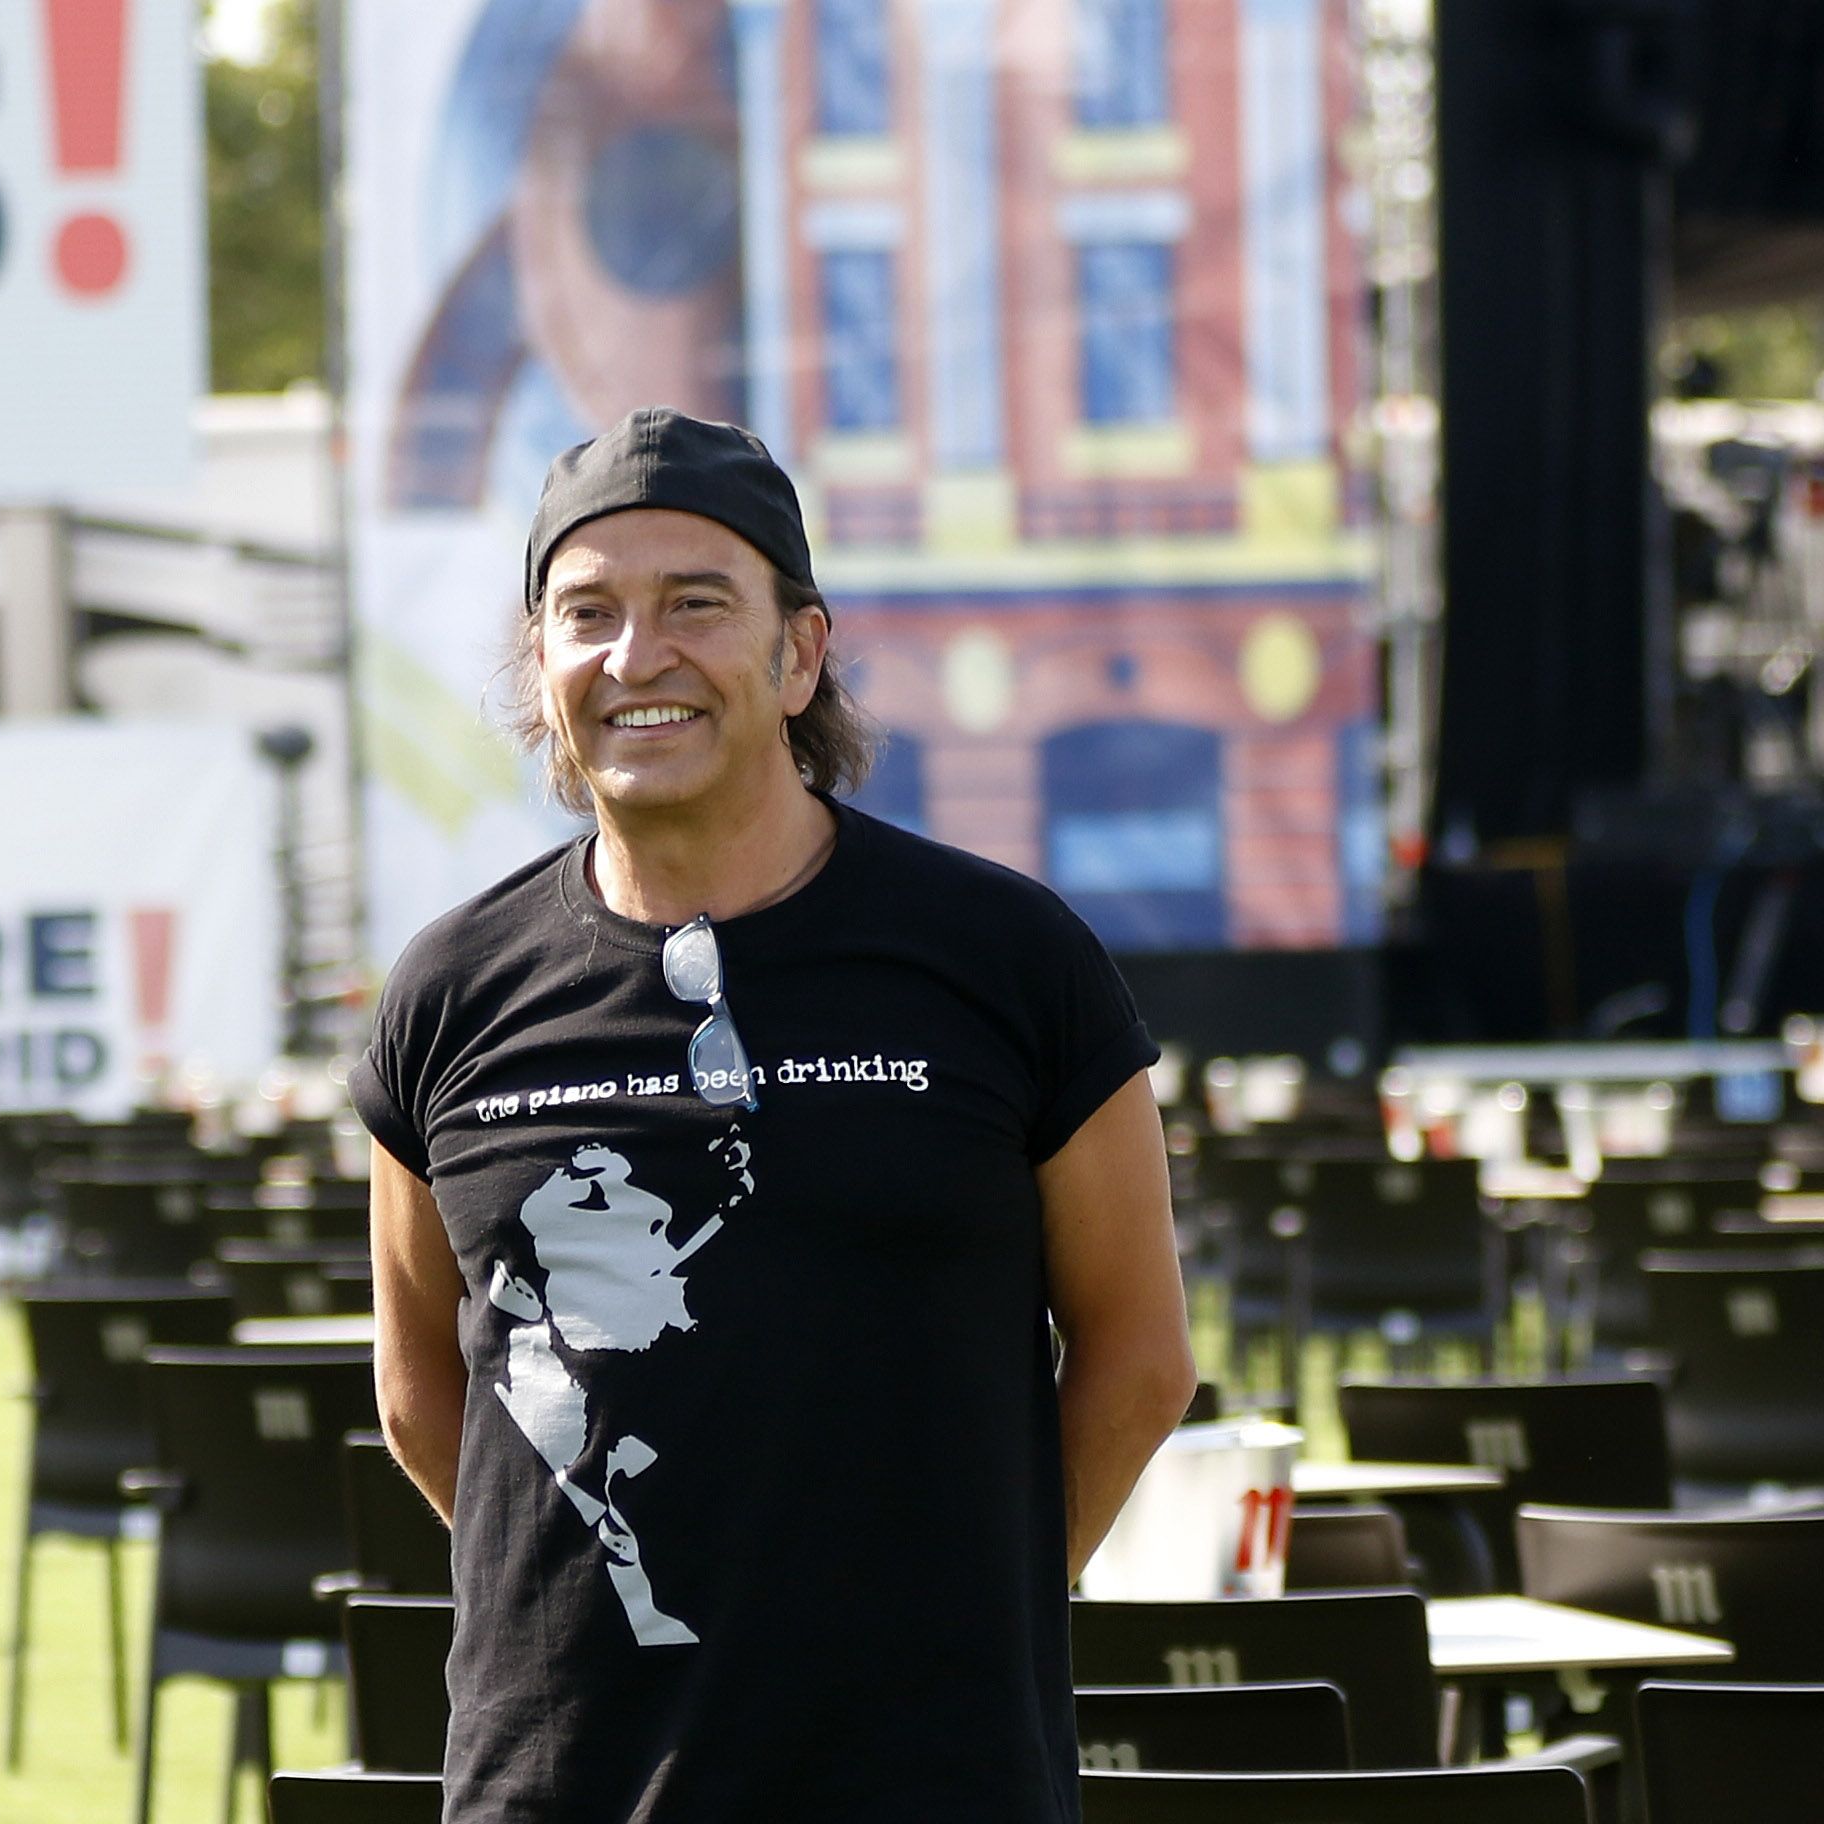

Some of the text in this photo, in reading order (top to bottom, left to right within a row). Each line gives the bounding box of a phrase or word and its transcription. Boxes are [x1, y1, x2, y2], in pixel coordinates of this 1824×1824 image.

[475, 1093, 520, 1123] the
[527, 1080, 618, 1115] piano
[626, 1073, 680, 1096] has
[776, 1053, 929, 1092] drinking
